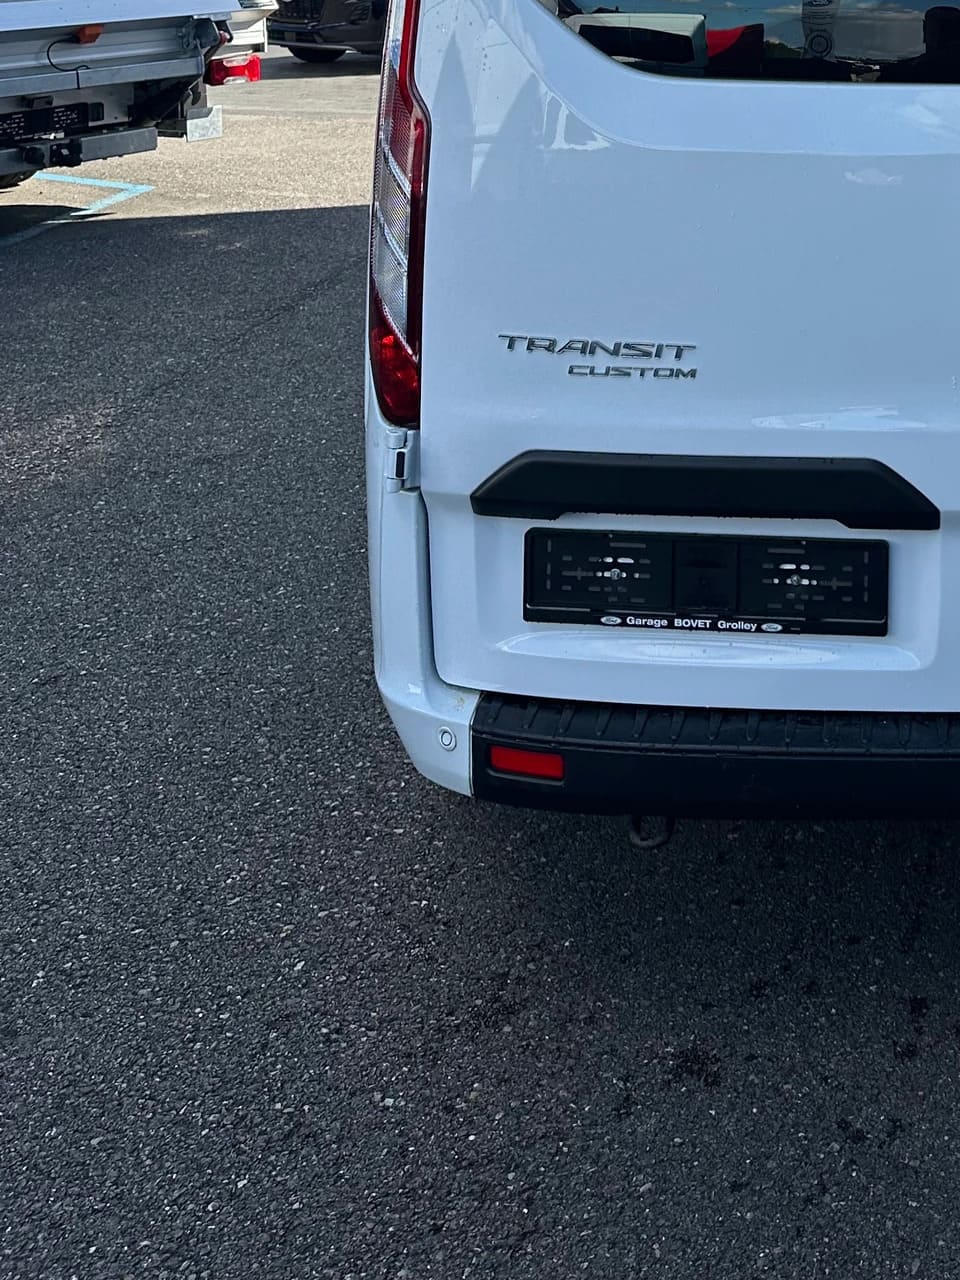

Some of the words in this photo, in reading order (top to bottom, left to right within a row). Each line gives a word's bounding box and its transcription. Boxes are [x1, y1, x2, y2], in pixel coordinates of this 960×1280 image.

[498, 334, 697, 361] TRANSIT
[568, 365, 698, 379] CUSTOM
[626, 616, 668, 628] Garage
[674, 618, 712, 628] BOVET
[717, 620, 757, 632] Grolley
